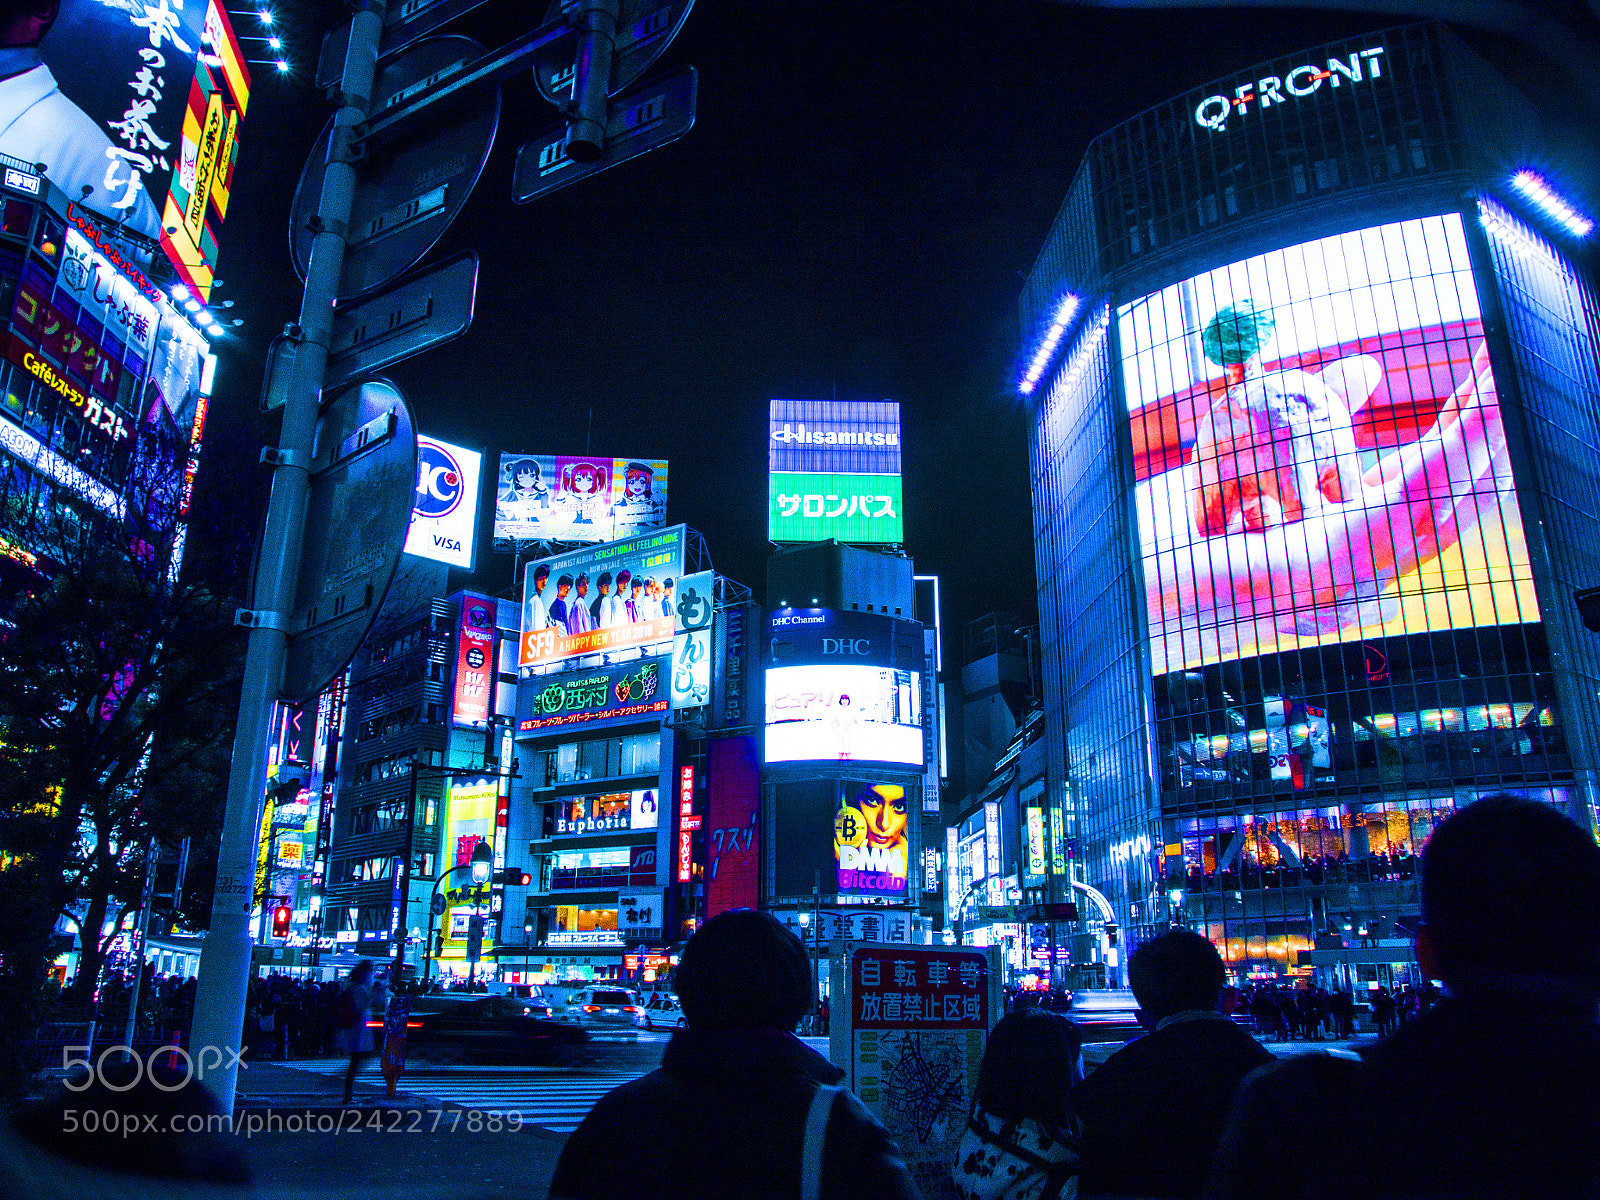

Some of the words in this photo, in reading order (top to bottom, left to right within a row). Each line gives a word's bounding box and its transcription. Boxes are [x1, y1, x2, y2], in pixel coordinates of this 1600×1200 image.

[1195, 46, 1384, 132] QFRONT
[104, 0, 196, 208] 本のお茶づけ
[67, 202, 162, 302] しゃぶしゃぶバイキング
[93, 273, 150, 342] しゃぶ葉
[16, 290, 115, 384] コンタクト
[23, 352, 85, 407] Caféレストラン
[83, 396, 128, 441] ガスト
[0, 425, 34, 458] AEON
[772, 424, 898, 445] Hisamitsu
[777, 494, 896, 518] サロンパス
[433, 534, 461, 552] VISA
[594, 543, 636, 561] SENSATIONAL
[663, 532, 679, 544] NINE
[773, 616, 791, 626] DHC
[791, 615, 825, 624] Channel
[526, 630, 555, 659] SF9
[559, 643, 565, 653] A
[565, 637, 591, 652] HAPPY
[591, 633, 609, 647] NEW
[610, 629, 632, 644] YEAR
[632, 624, 654, 640] 2018
[675, 587, 711, 702] もんじゃ
[822, 638, 870, 655] DHC
[566, 685, 608, 710] 西村
[557, 817, 628, 834] Euphoria
[985, 803, 1000, 873] 洋の山
[283, 843, 299, 859] 薬
[632, 849, 655, 869] JTB
[840, 845, 905, 873] DMM
[839, 870, 905, 891] Bitcoin
[861, 957, 981, 988] 自転車等
[861, 991, 981, 1022] 放置禁止区域
